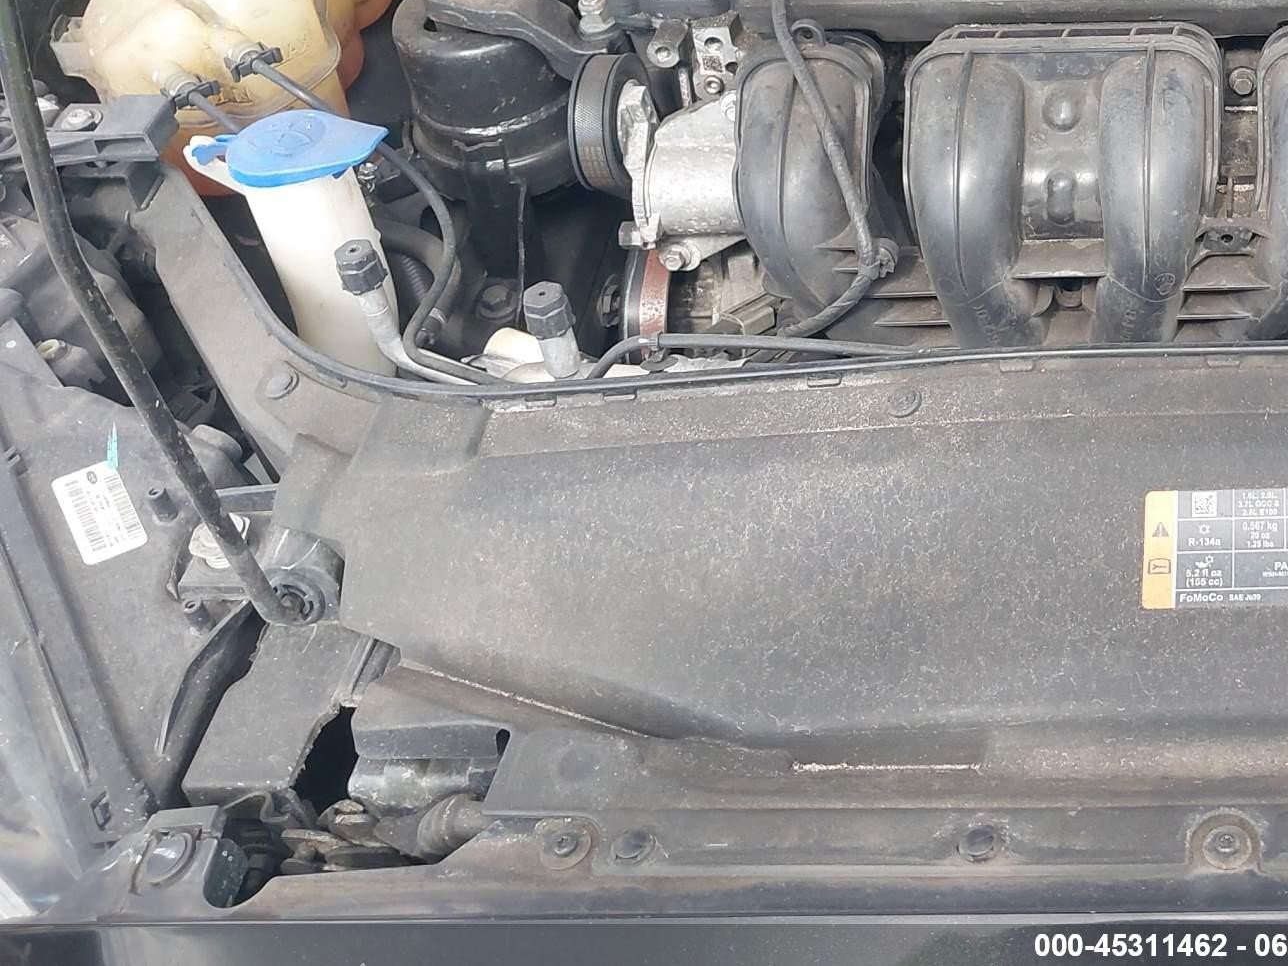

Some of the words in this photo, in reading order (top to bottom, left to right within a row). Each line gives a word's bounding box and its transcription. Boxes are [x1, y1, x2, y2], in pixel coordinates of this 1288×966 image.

[1266, 521, 1278, 532] kg
[1188, 537, 1221, 546] R-134a
[1262, 539, 1274, 548] lbs
[1185, 568, 1200, 578] 5.2
[1201, 568, 1209, 578] fl
[1210, 569, 1223, 577] oz
[1208, 577, 1223, 587] cc)
[1179, 592, 1224, 603] FoMoCo
